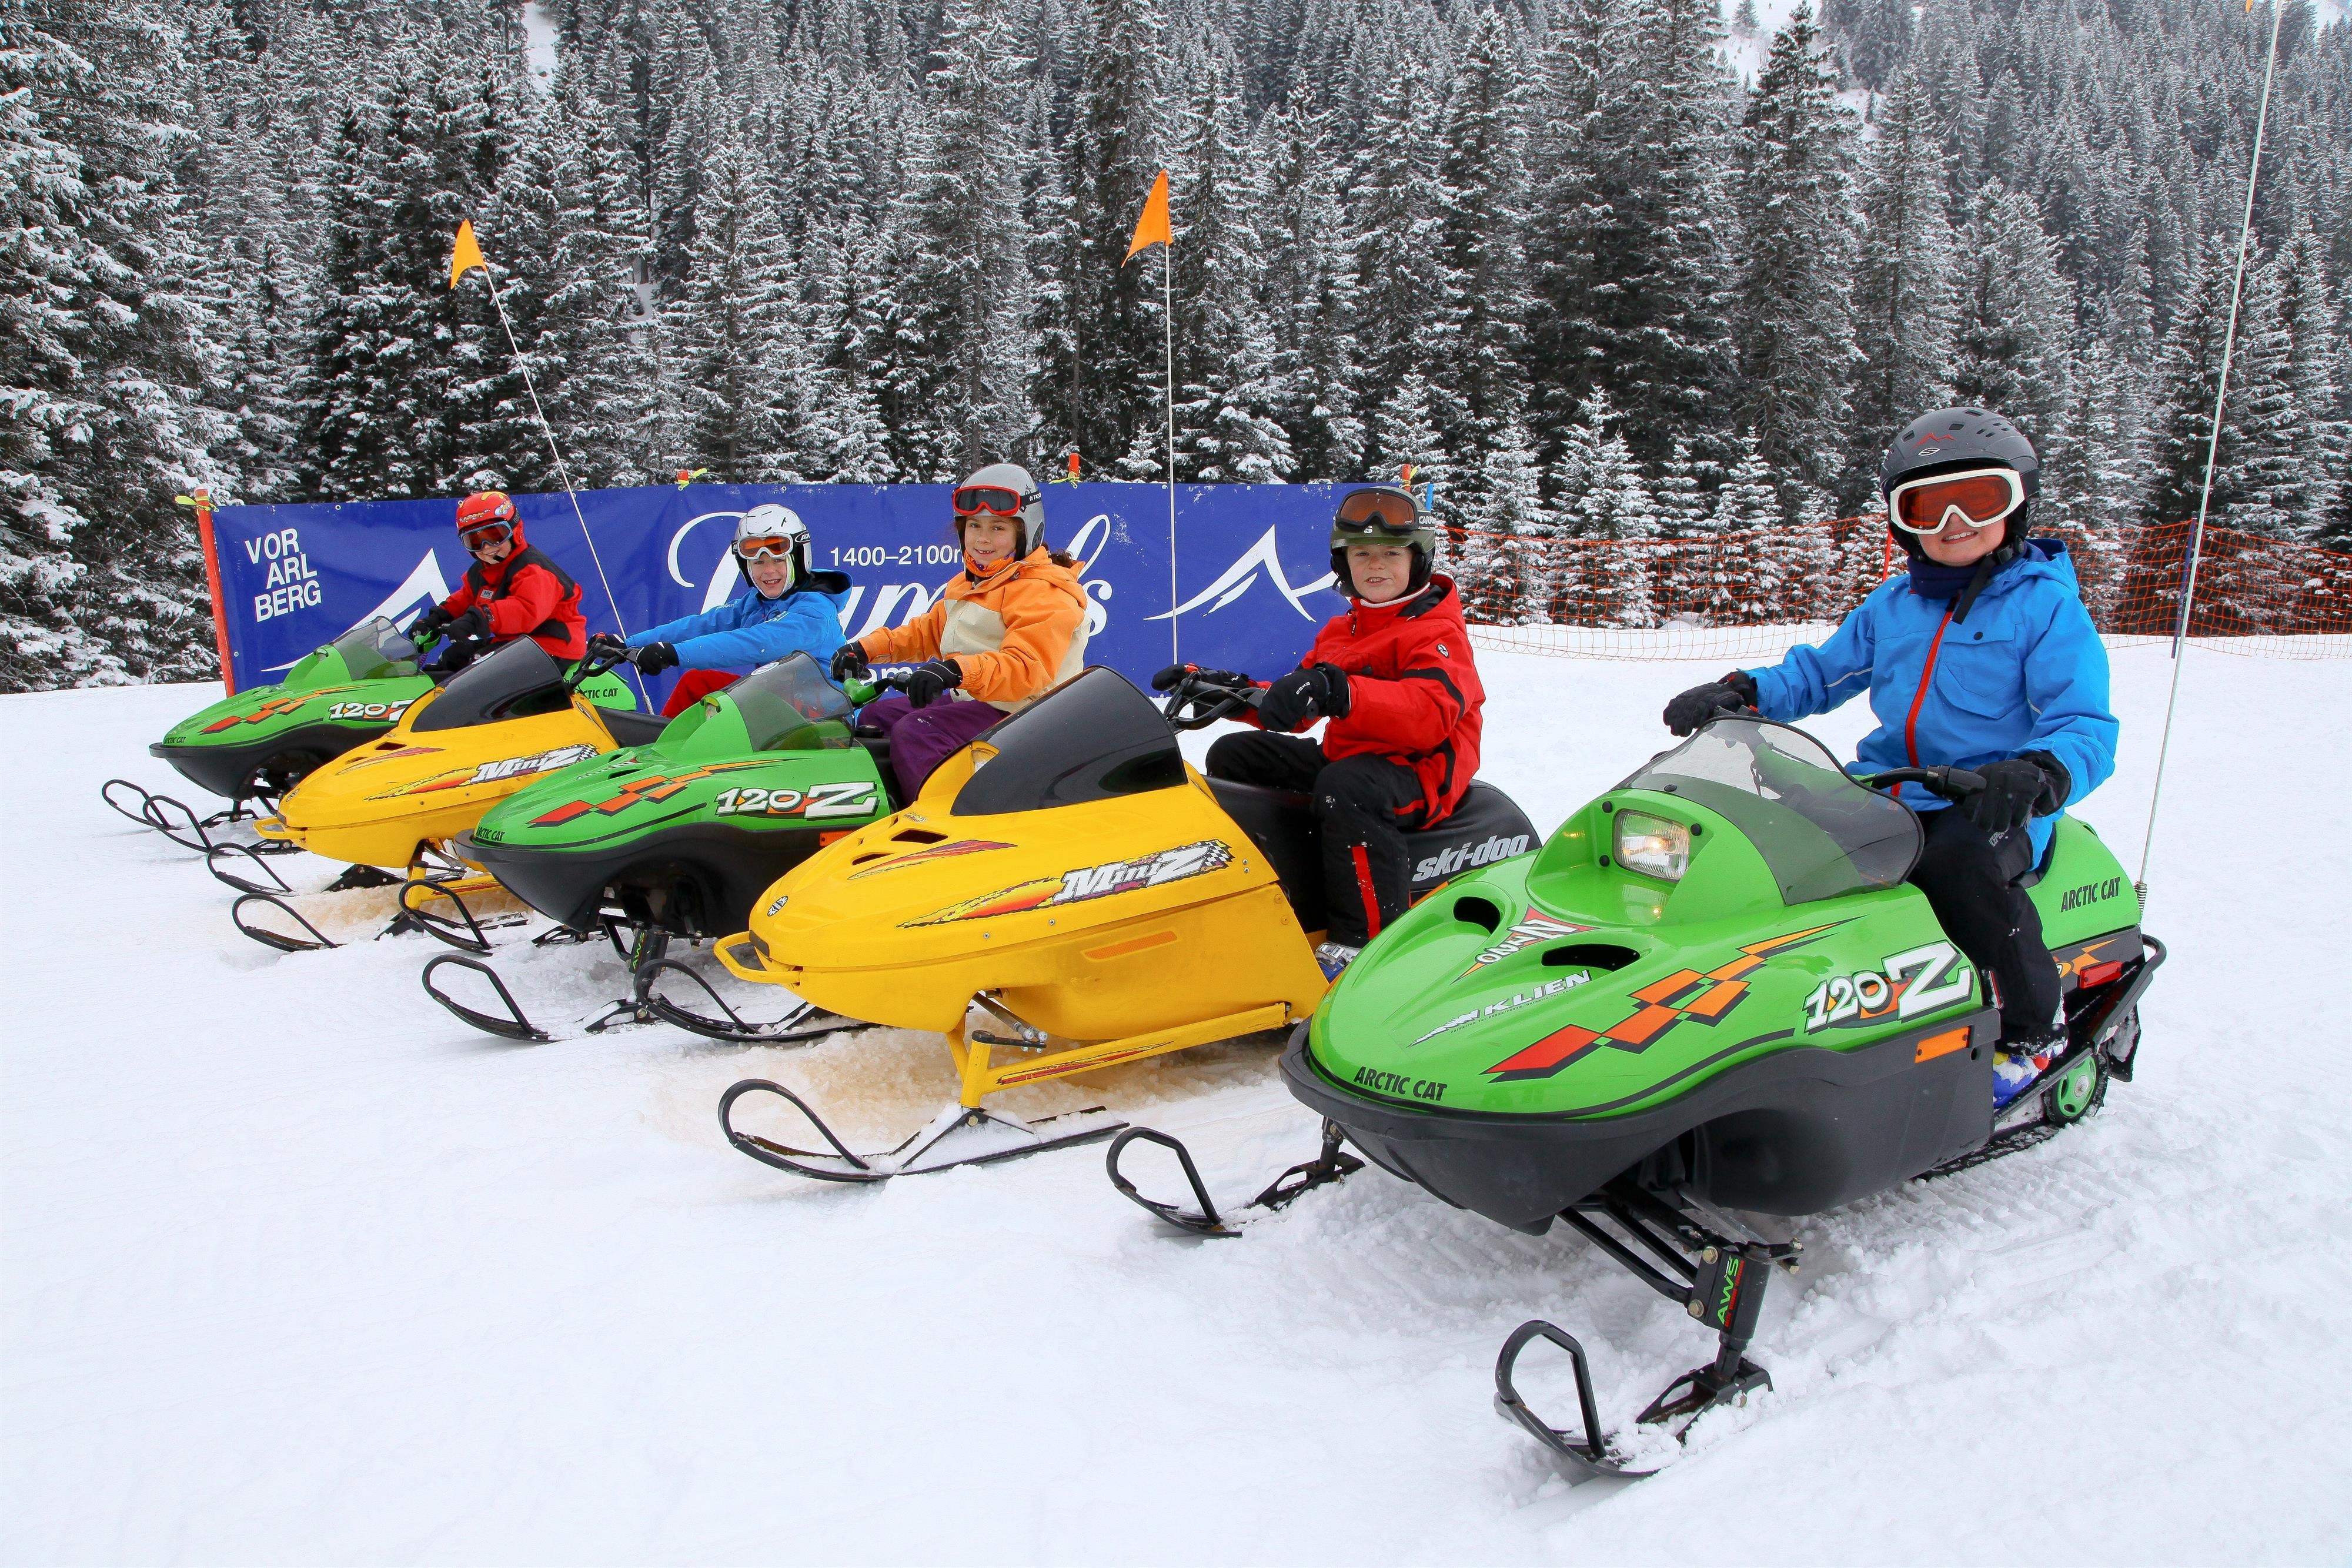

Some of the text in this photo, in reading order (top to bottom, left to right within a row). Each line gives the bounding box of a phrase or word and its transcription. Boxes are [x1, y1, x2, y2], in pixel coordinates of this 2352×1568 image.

[244, 528, 300, 564] VOR
[266, 553, 318, 590] ARL
[255, 580, 322, 623] BERG
[603, 688, 619, 698] CAT
[491, 830, 506, 841] CAT
[1412, 834, 1529, 882] ski-doo
[2060, 877, 2120, 914] ARCTIC CAT
[1484, 969, 1592, 1016] KLIEN
[1354, 1066, 1448, 1101] ARCTIC CAT
[1717, 1258, 1739, 1325] AWS
